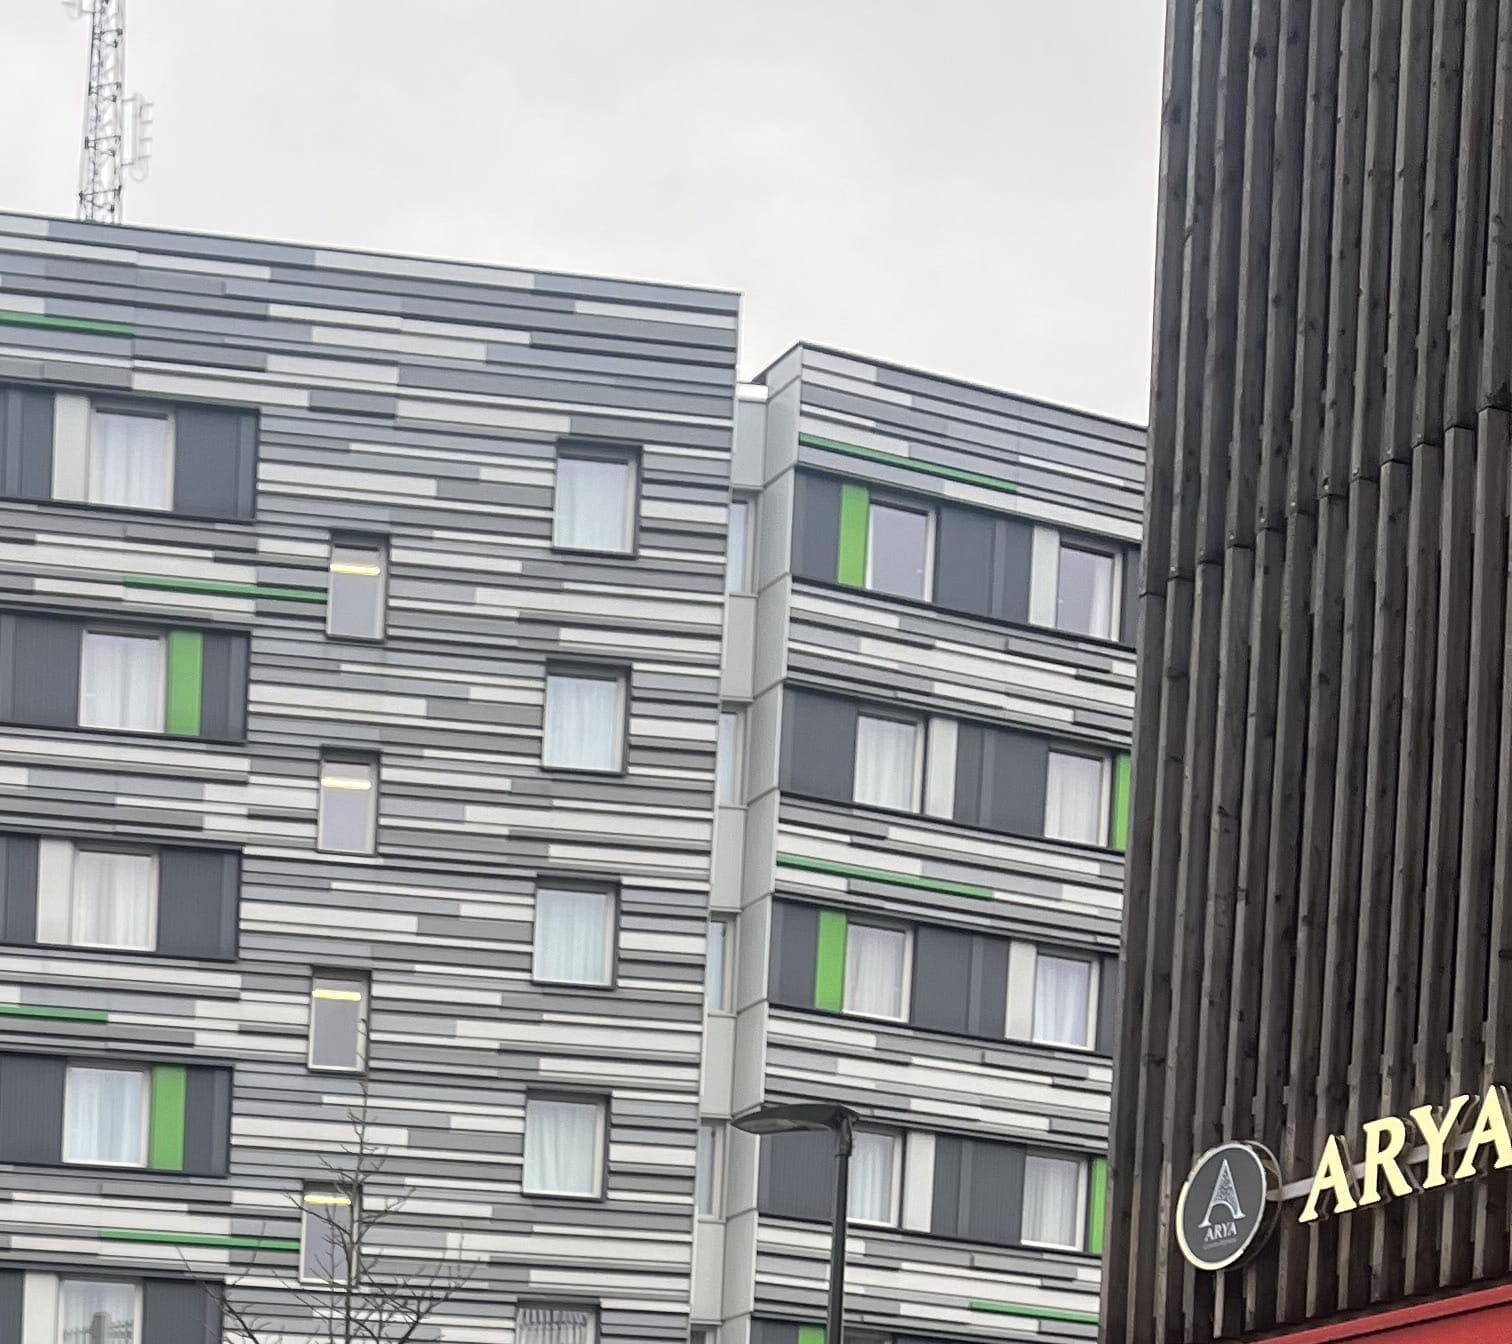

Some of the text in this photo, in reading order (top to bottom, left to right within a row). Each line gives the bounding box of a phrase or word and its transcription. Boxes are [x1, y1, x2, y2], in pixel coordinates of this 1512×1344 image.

[1298, 1084, 1512, 1223] ARYA
[1198, 1158, 1246, 1228] A
[1204, 1222, 1237, 1242] ARYA
